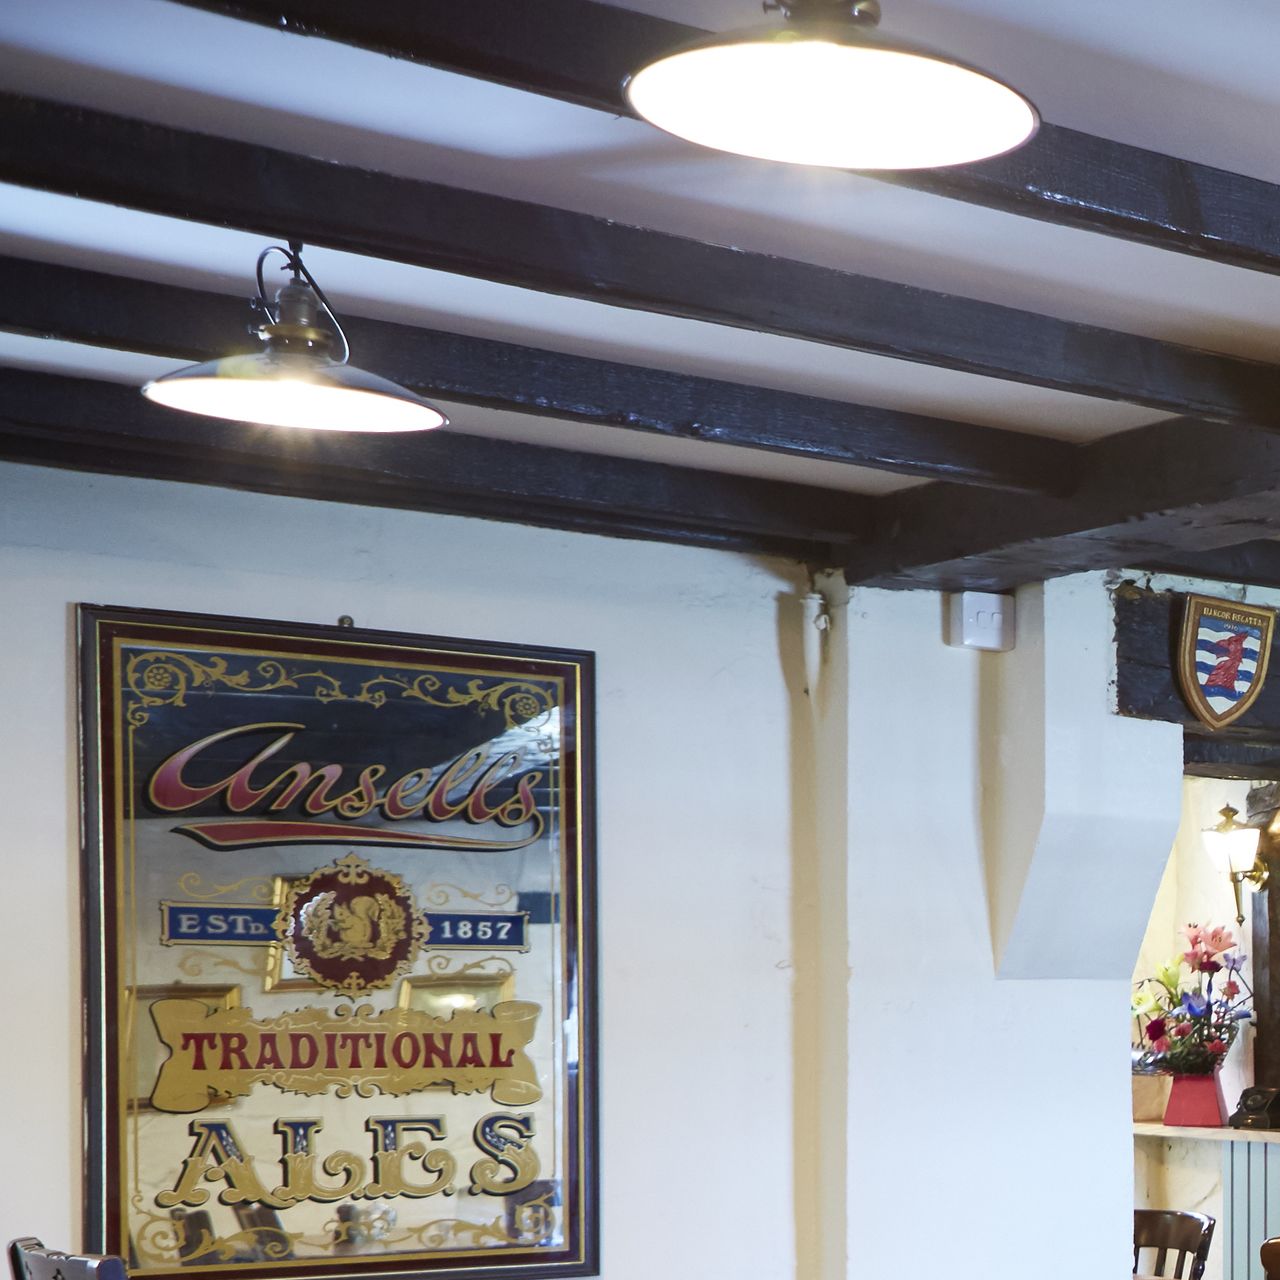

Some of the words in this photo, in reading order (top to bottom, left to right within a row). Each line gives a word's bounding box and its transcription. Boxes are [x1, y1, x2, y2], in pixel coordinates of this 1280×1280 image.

[149, 721, 543, 828] Ansells
[441, 921, 513, 941] 1857
[181, 1031, 515, 1071] TRADITIONAL
[155, 1111, 543, 1209] ALES
